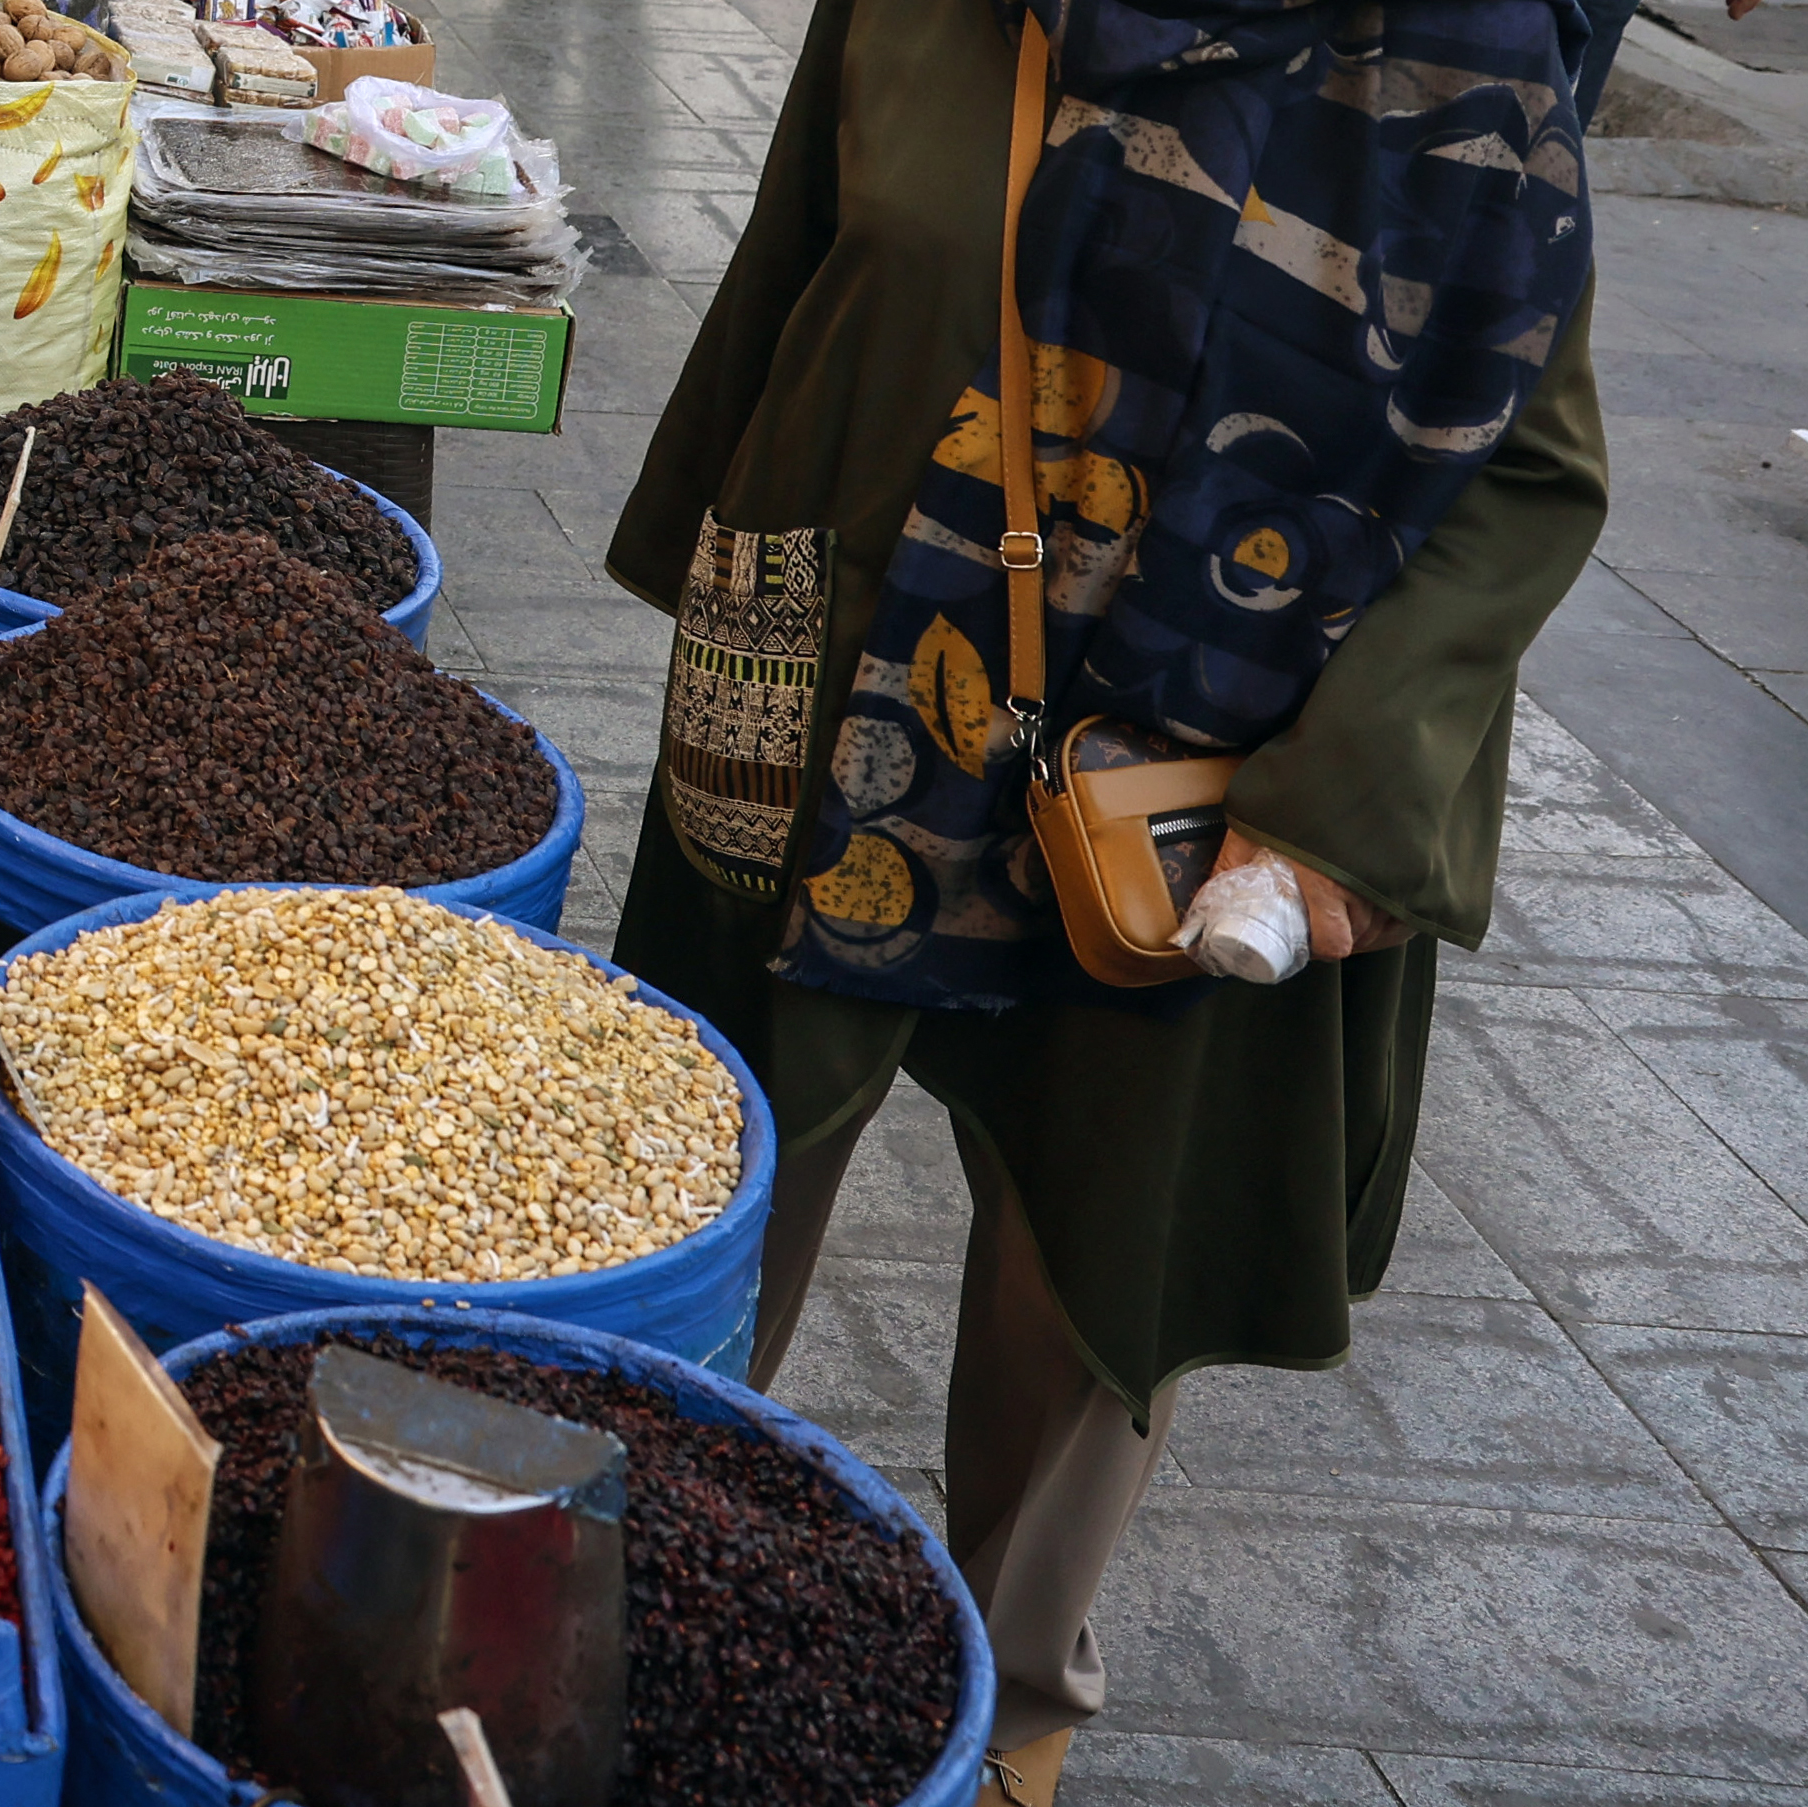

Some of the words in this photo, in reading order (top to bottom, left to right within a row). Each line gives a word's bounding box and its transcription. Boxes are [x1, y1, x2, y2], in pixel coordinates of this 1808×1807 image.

[165, 309, 195, 321] آفتاب
[197, 310, 240, 324] نگهداری
[174, 330, 204, 341] خشک
[243, 333, 262, 343] دور
[264, 335, 275, 346] از
[153, 360, 178, 371] Date
[217, 364, 243, 376] IRAN
[245, 355, 290, 398] ایران
